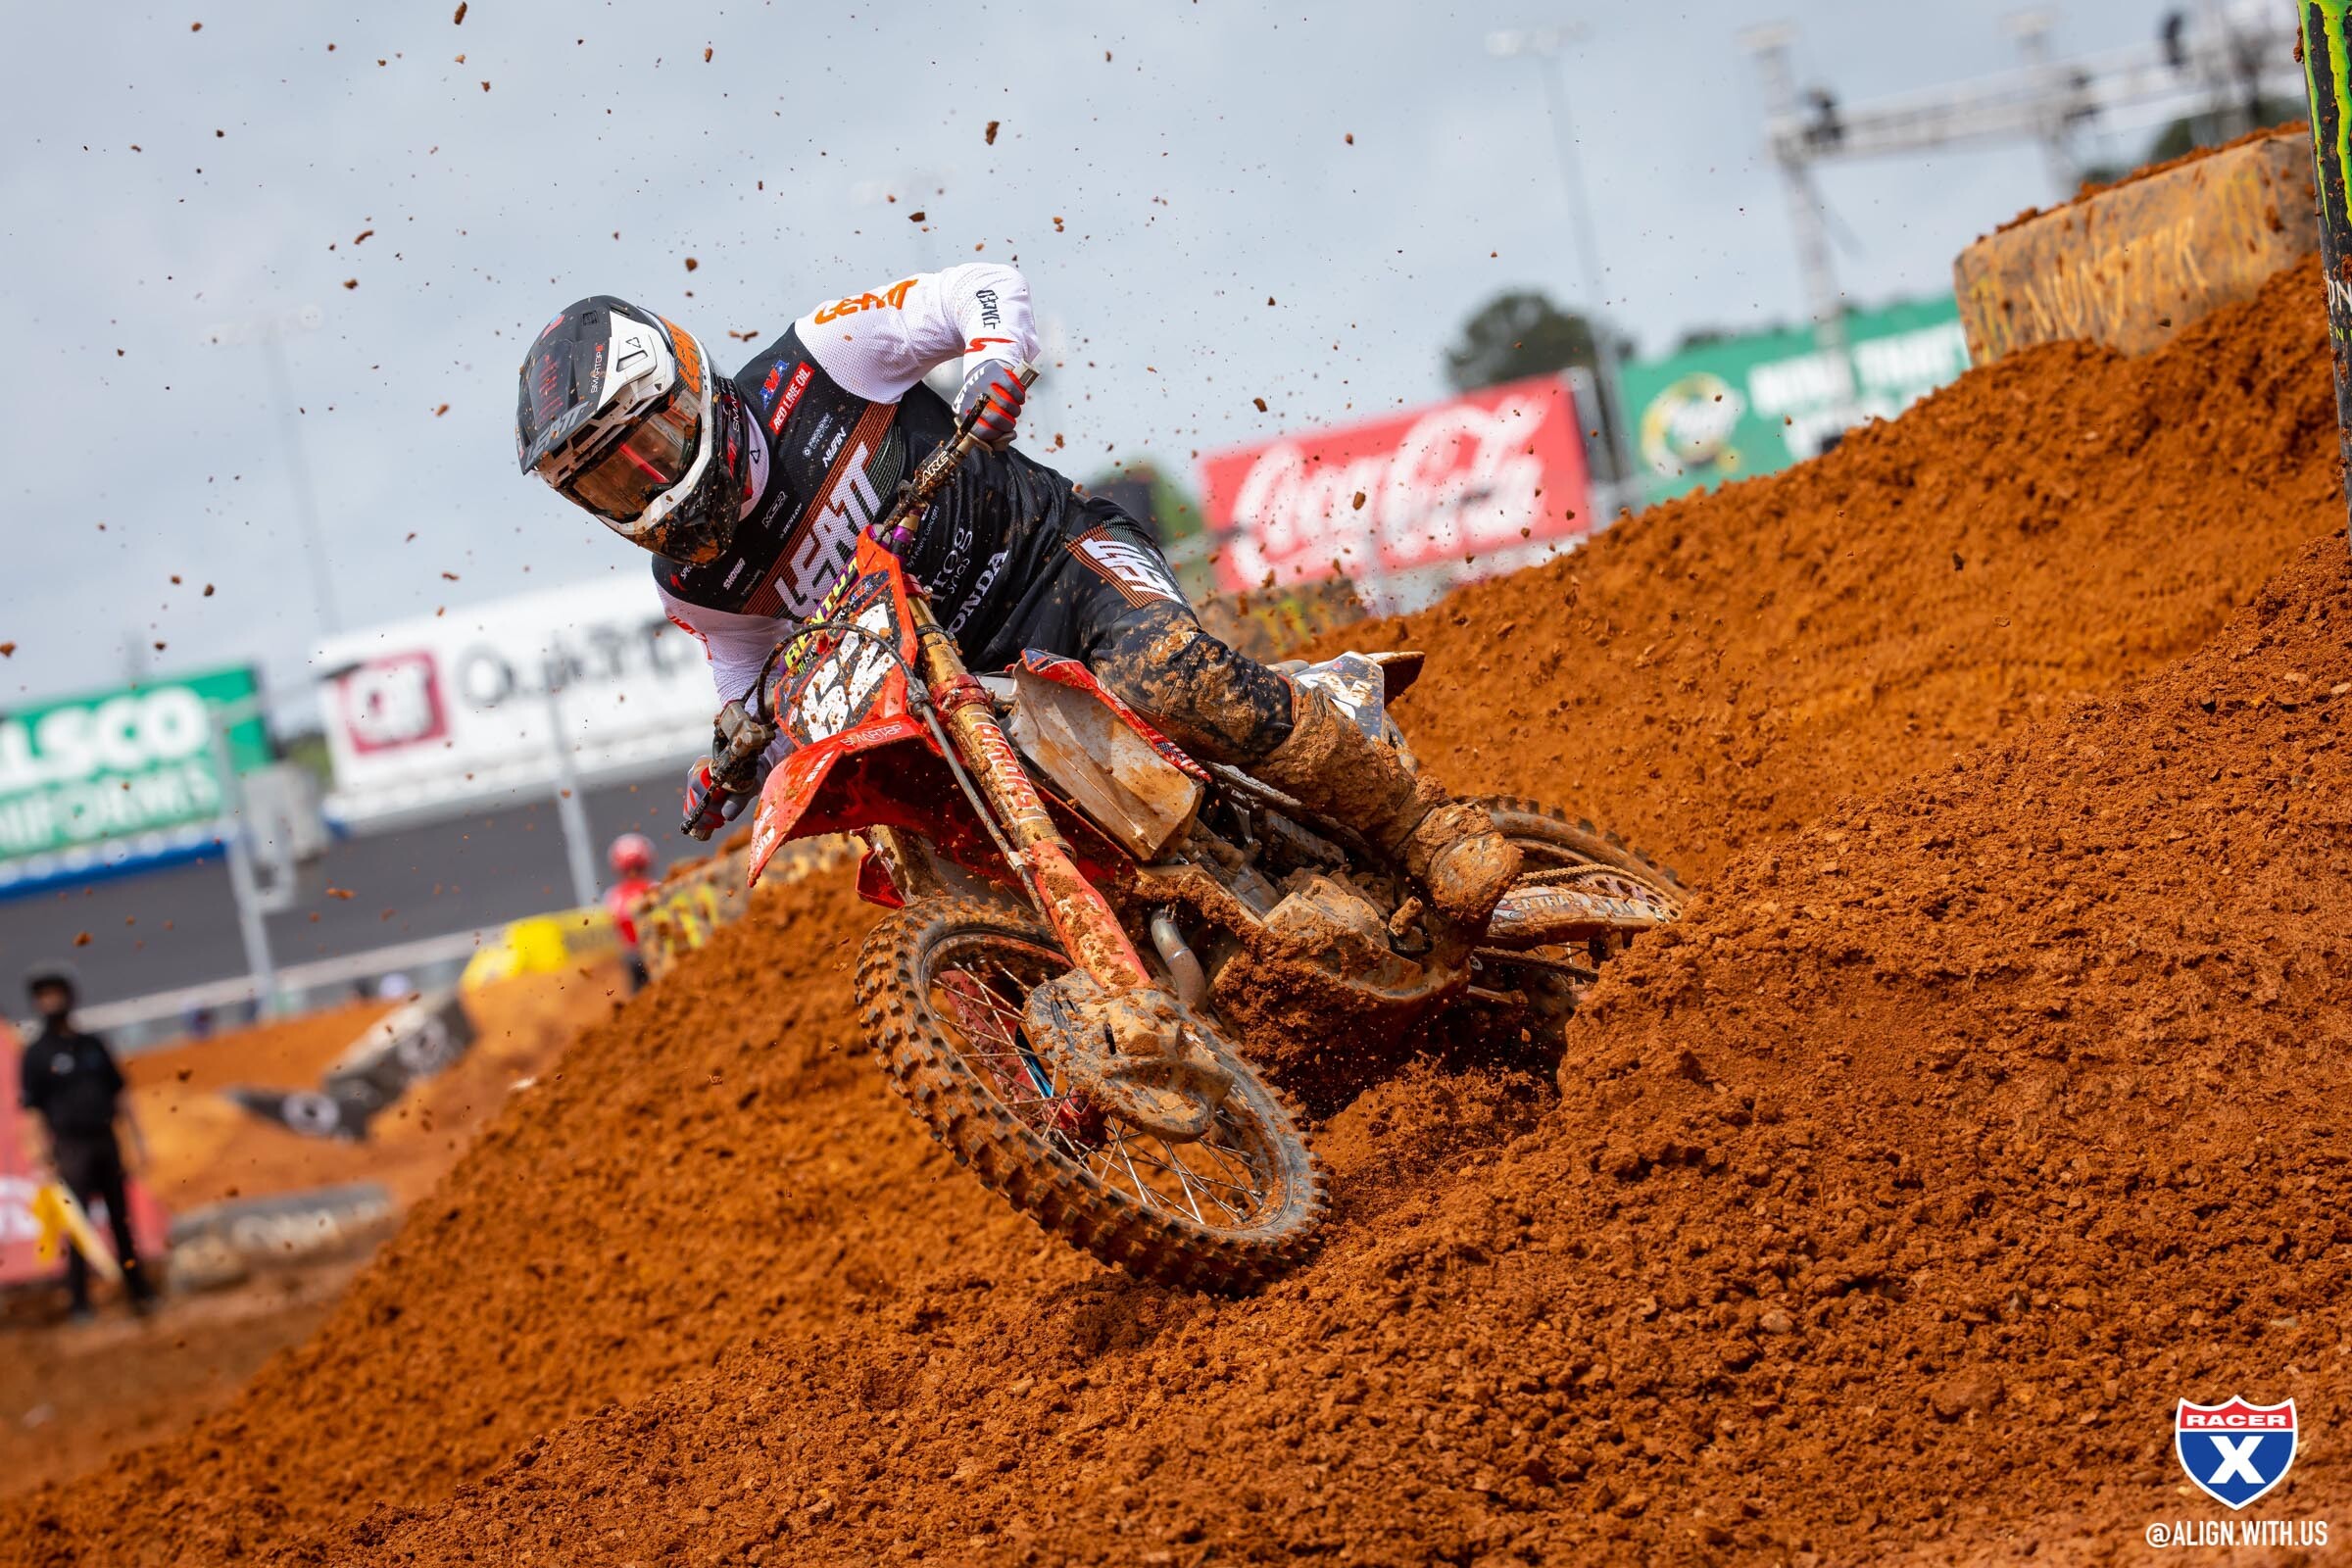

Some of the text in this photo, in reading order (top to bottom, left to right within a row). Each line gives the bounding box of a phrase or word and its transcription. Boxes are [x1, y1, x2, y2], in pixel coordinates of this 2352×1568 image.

[772, 368, 811, 430] RED LINE OIL
[921, 450, 950, 487] ARC
[774, 441, 881, 619] LEATT
[782, 502, 803, 535] DUNLOP
[723, 557, 746, 590] SHOWA
[948, 550, 1009, 634] ONDA
